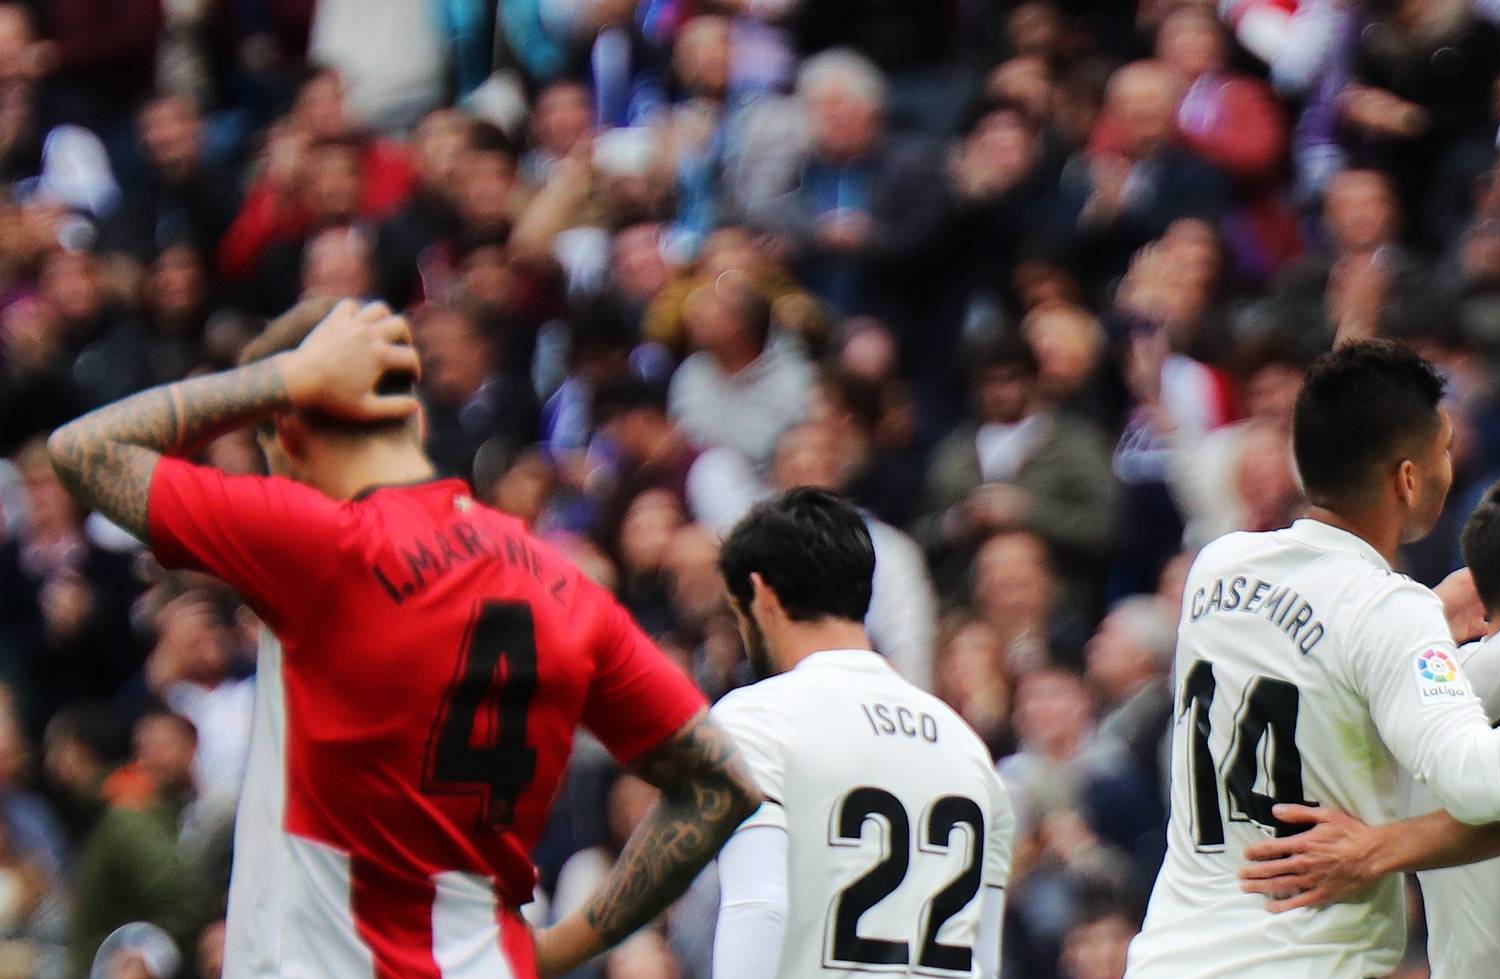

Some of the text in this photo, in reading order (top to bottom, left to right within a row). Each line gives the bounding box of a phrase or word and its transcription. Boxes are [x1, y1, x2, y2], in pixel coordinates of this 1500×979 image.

[1189, 575, 1326, 657] CASEMIRO
[420, 598, 539, 832] 4
[861, 703, 938, 744] ISCO
[1177, 658, 1320, 854] 14
[1422, 686, 1465, 698] LaLiga
[820, 785, 985, 979] 22
